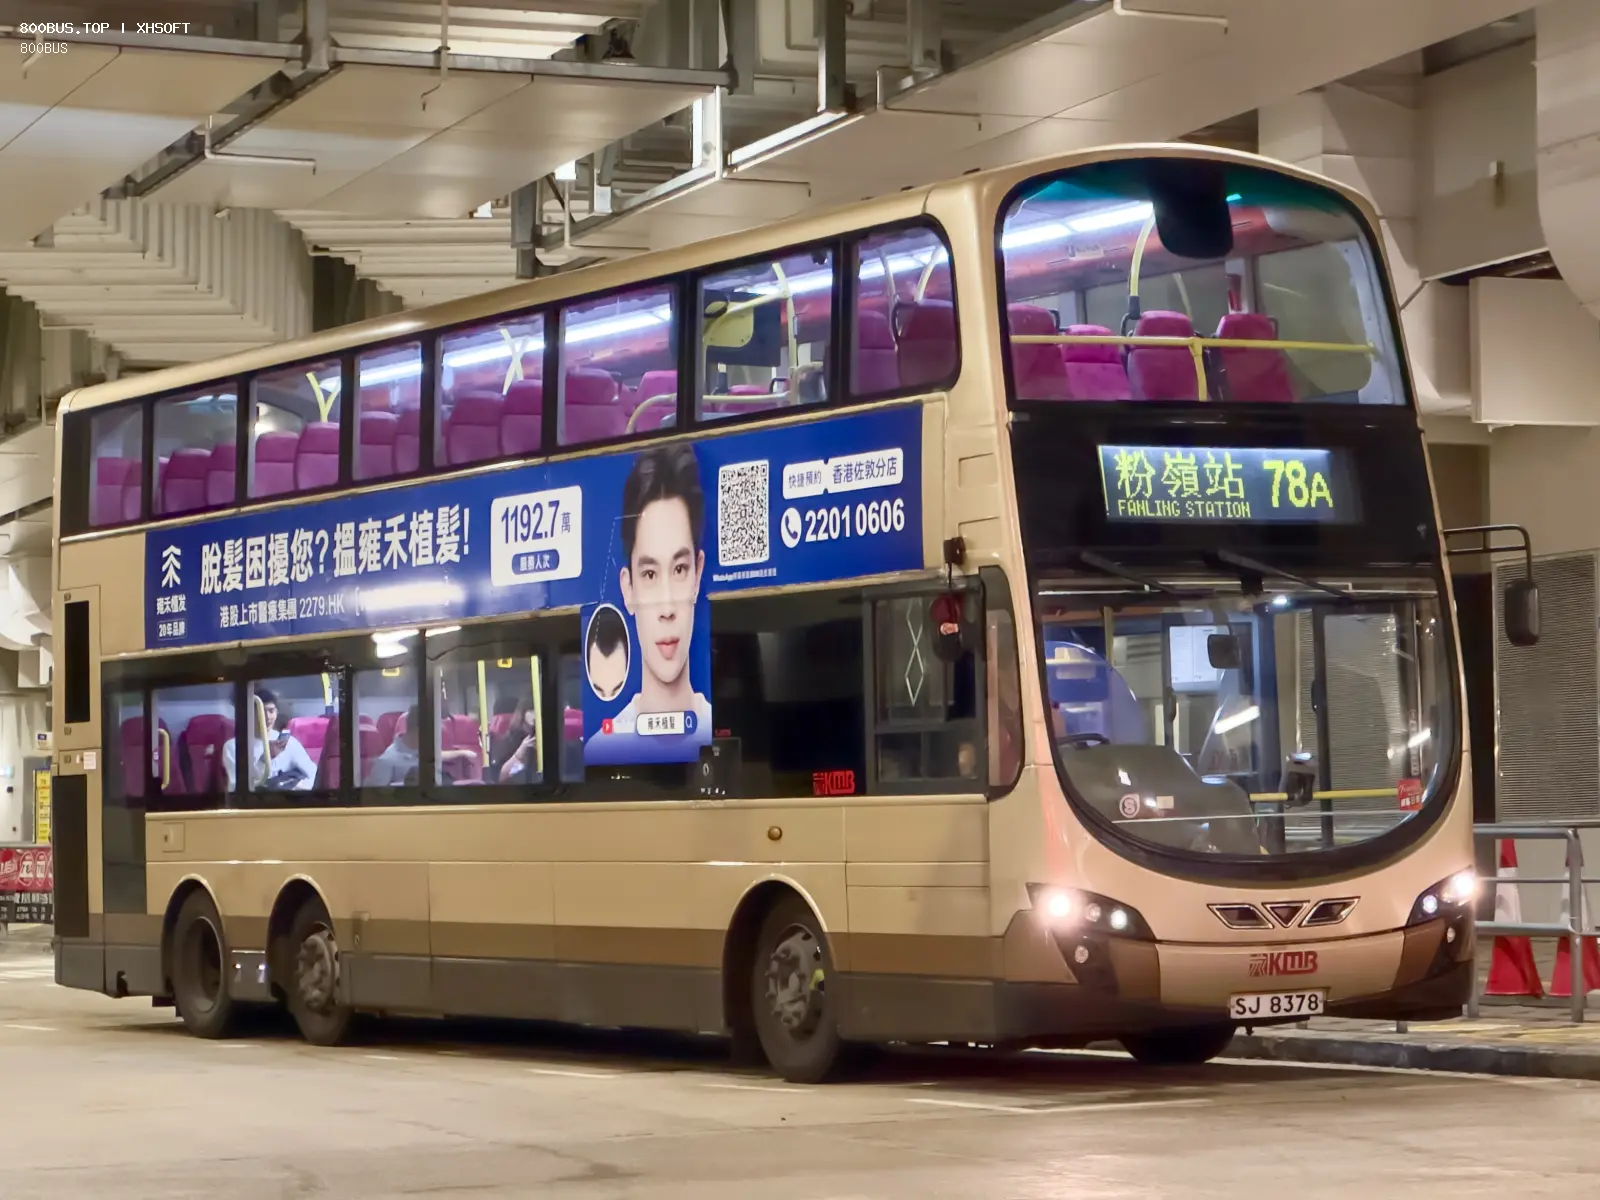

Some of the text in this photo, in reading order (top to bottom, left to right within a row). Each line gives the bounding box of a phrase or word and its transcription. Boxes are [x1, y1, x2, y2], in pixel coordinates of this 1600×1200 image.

[788, 457, 898, 489] 快捷預約 香港佐敦分店
[1113, 449, 1245, 499] 粉嶺站
[1262, 459, 1334, 508] 78A
[804, 498, 905, 543] 2201 0606
[1117, 499, 1251, 519] FANLING STATION
[299, 593, 345, 619] 2279.HK
[1268, 950, 1318, 976] KMB
[1235, 993, 1319, 1015] SJ 8378
